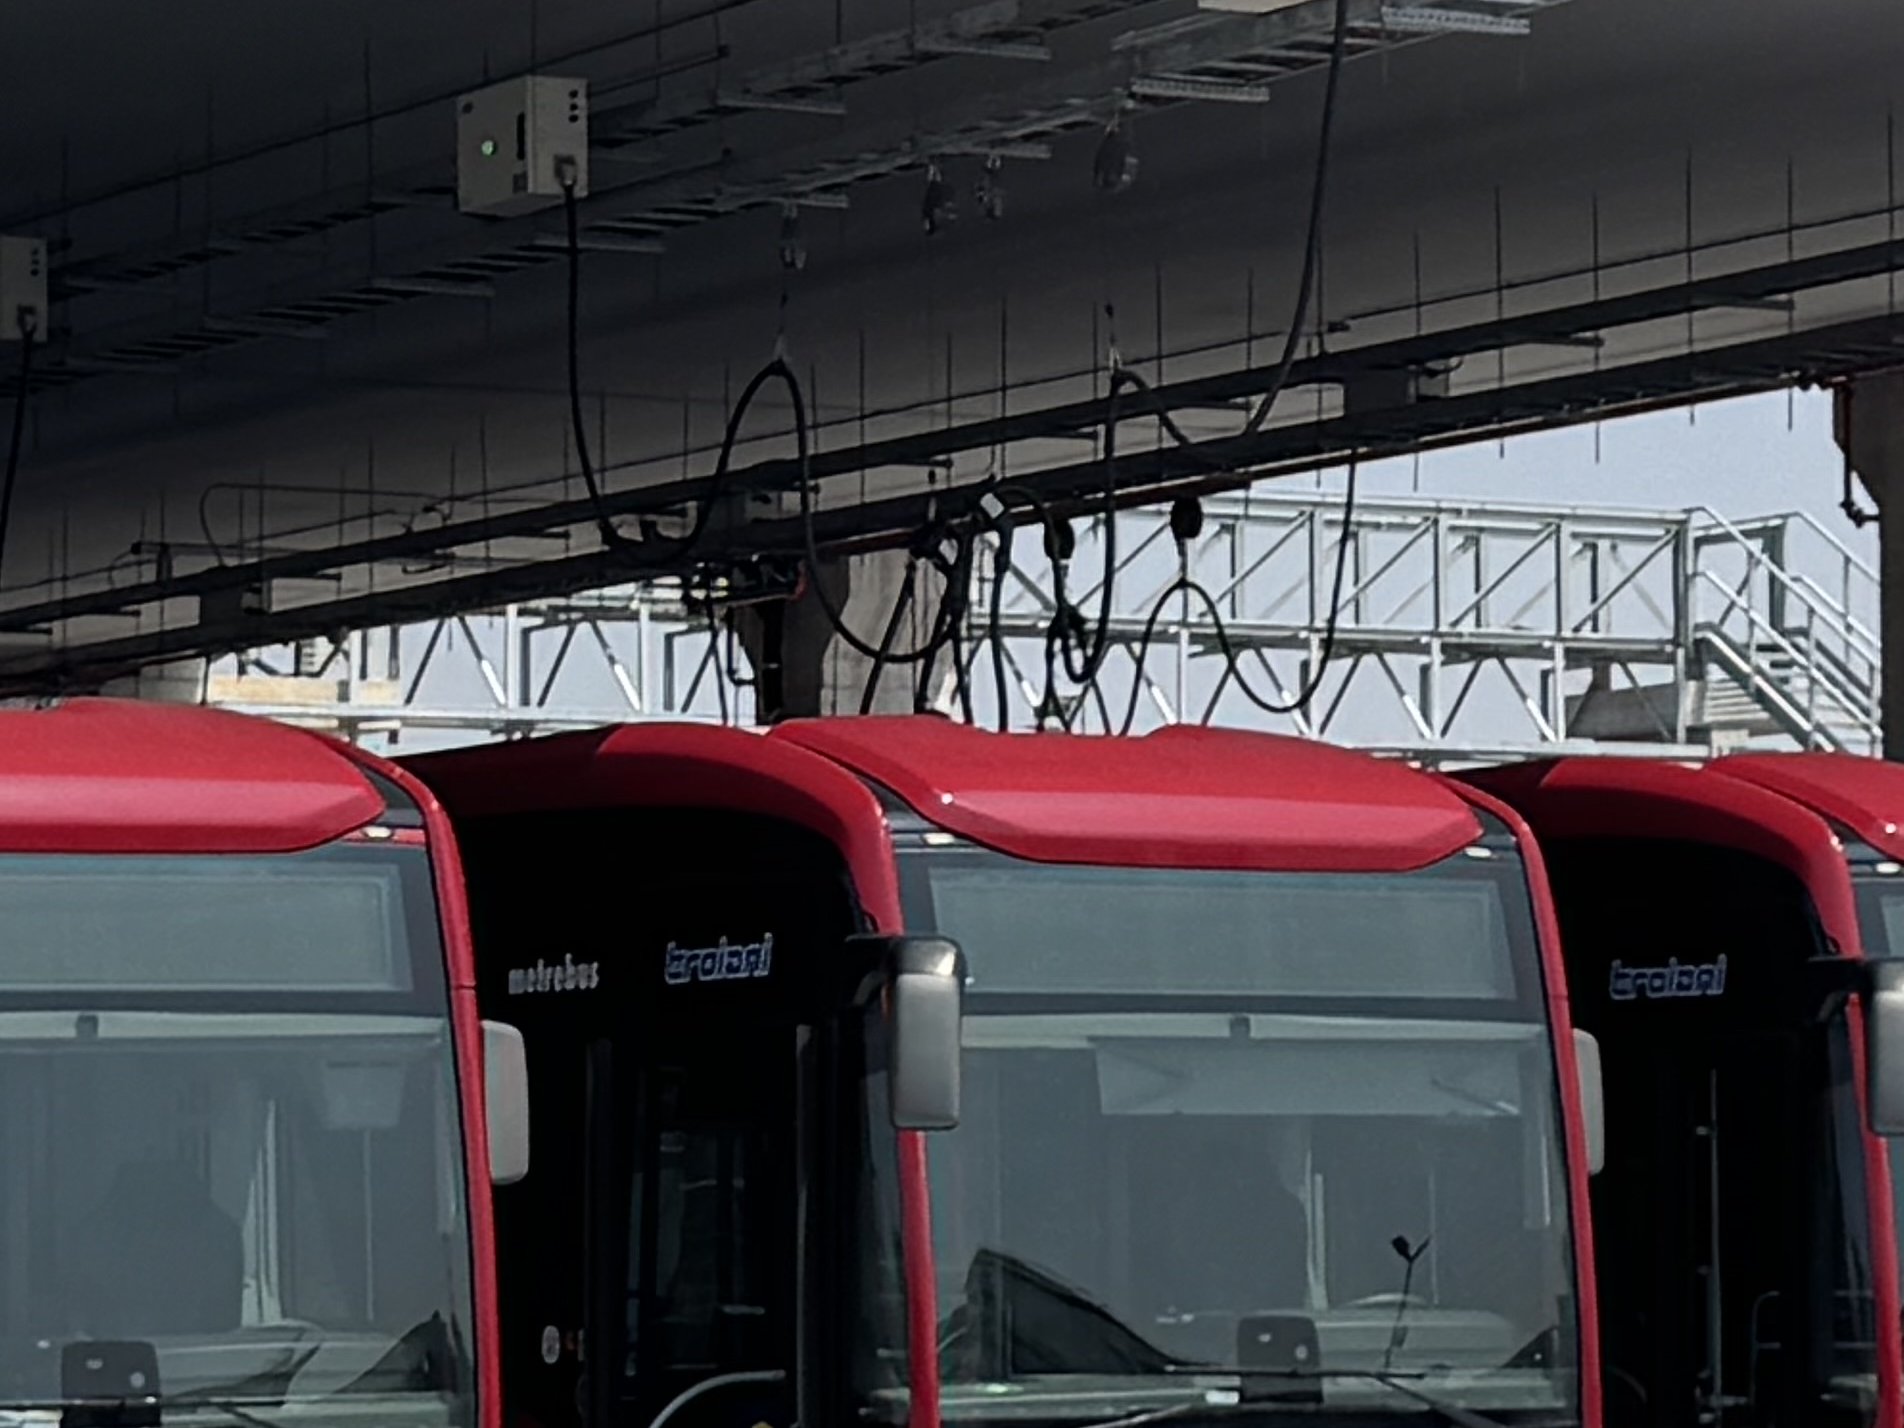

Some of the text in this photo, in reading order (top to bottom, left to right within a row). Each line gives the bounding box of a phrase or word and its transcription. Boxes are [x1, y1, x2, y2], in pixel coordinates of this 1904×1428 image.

[508, 952, 599, 995] metrobus
[665, 932, 773, 985] troiani
[1609, 953, 1728, 1001] troiani
